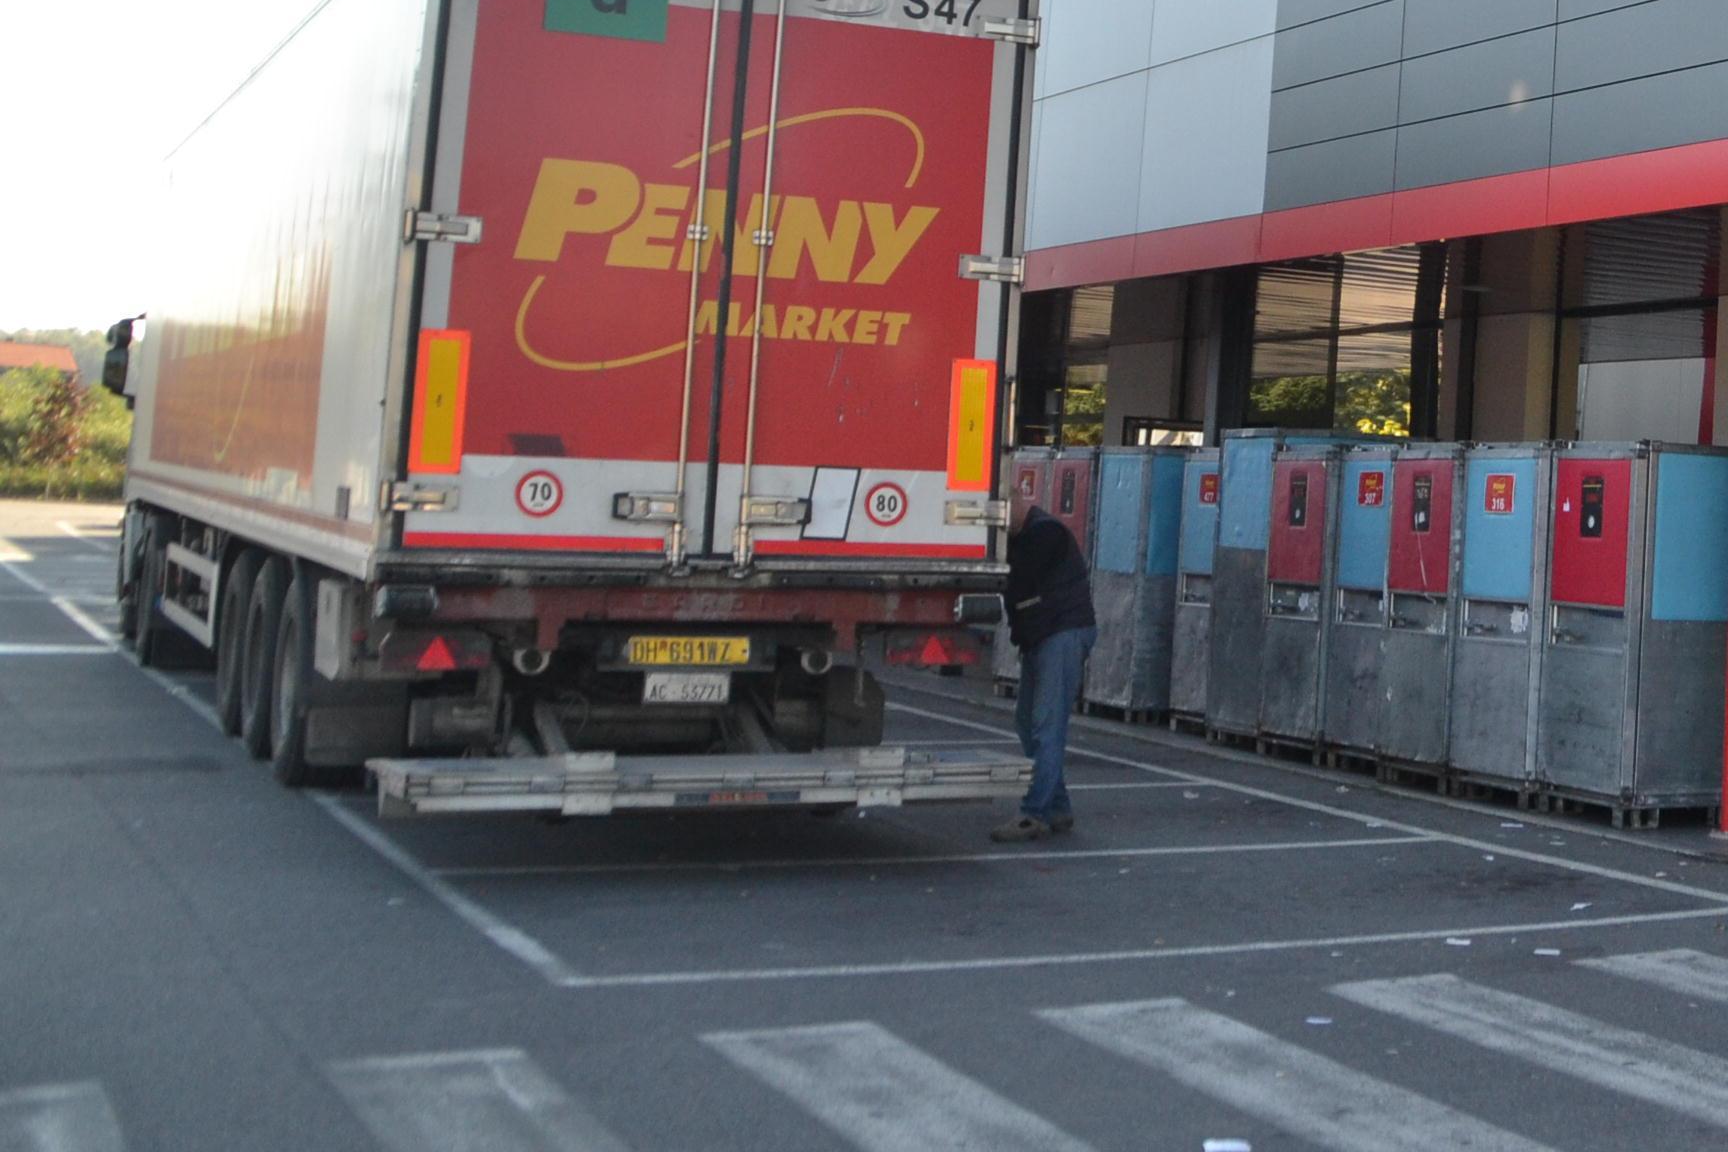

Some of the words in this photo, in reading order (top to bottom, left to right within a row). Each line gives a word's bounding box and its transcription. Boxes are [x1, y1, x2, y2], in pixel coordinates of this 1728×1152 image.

[513, 158, 940, 285] PENNY
[696, 300, 911, 346] MARKET
[529, 482, 552, 502] 70
[876, 494, 897, 513] 80
